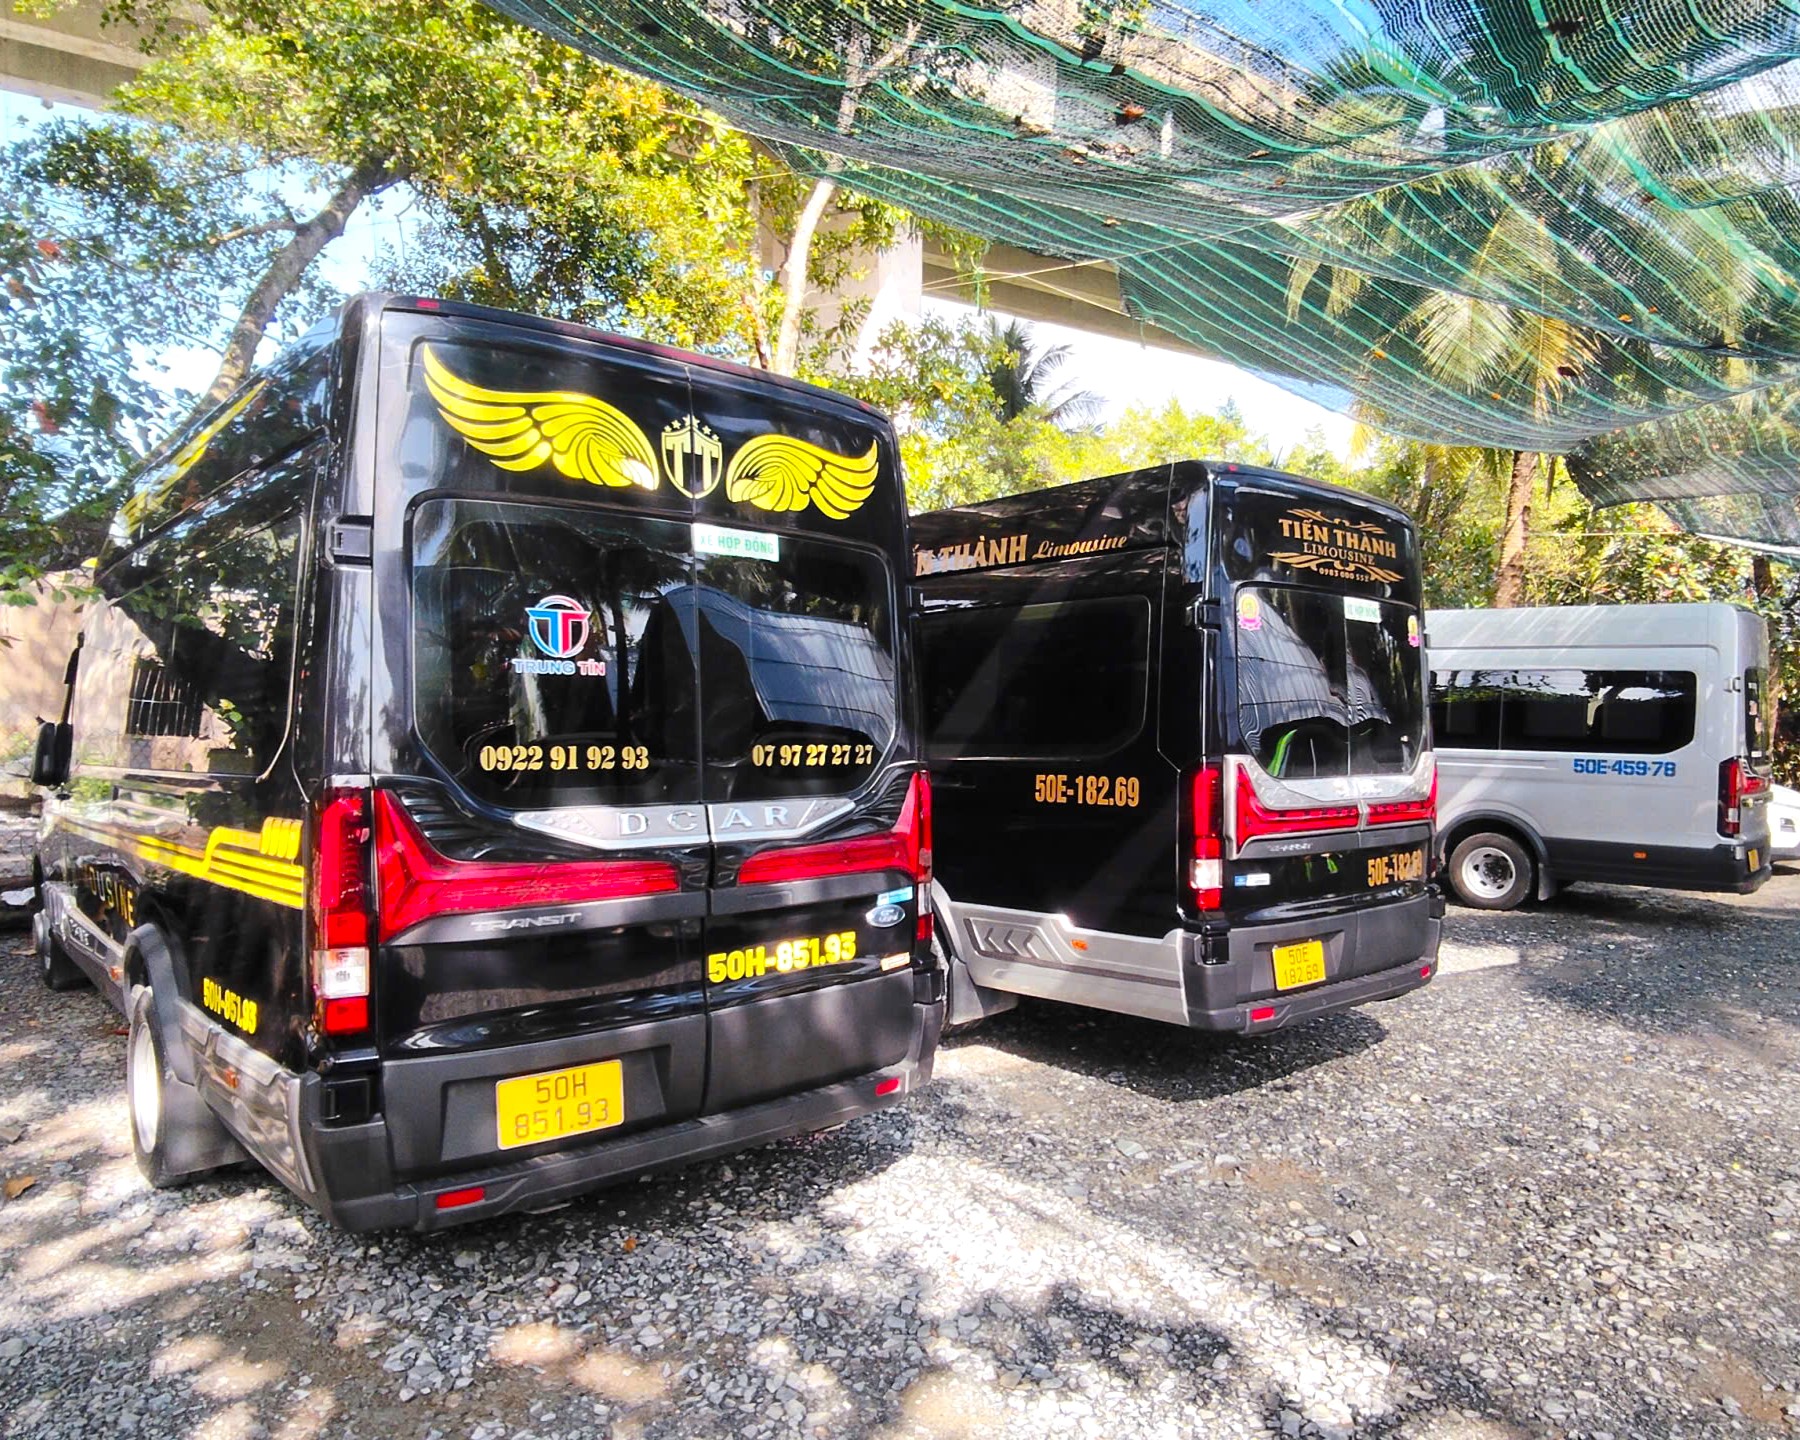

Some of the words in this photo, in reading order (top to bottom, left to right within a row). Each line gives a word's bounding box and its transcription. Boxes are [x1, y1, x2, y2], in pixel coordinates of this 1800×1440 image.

[938, 535, 1028, 572] THÀNH
[1032, 534, 1128, 560] Limousine
[1303, 542, 1376, 566] LIMOUSINE
[1333, 529, 1397, 559] THÀNH
[512, 659, 576, 675] TRUNG
[577, 658, 606, 676] TÍN
[480, 745, 544, 771] 0922
[550, 745, 578, 770] 91
[586, 745, 615, 770] 92
[621, 746, 650, 770] 93
[752, 744, 776, 767] 07
[780, 744, 803, 766] 97
[805, 744, 828, 766] 27
[831, 744, 852, 766] 27
[855, 744, 874, 765] 27
[1034, 774, 1140, 807] 50E-182.69
[471, 912, 582, 932] TRANSIT
[707, 931, 857, 983] 50H-851.93
[1288, 946, 1309, 965] 50E
[1284, 963, 1319, 986] 182.69
[536, 1071, 588, 1104] 50H
[514, 1097, 609, 1139] 851.93
